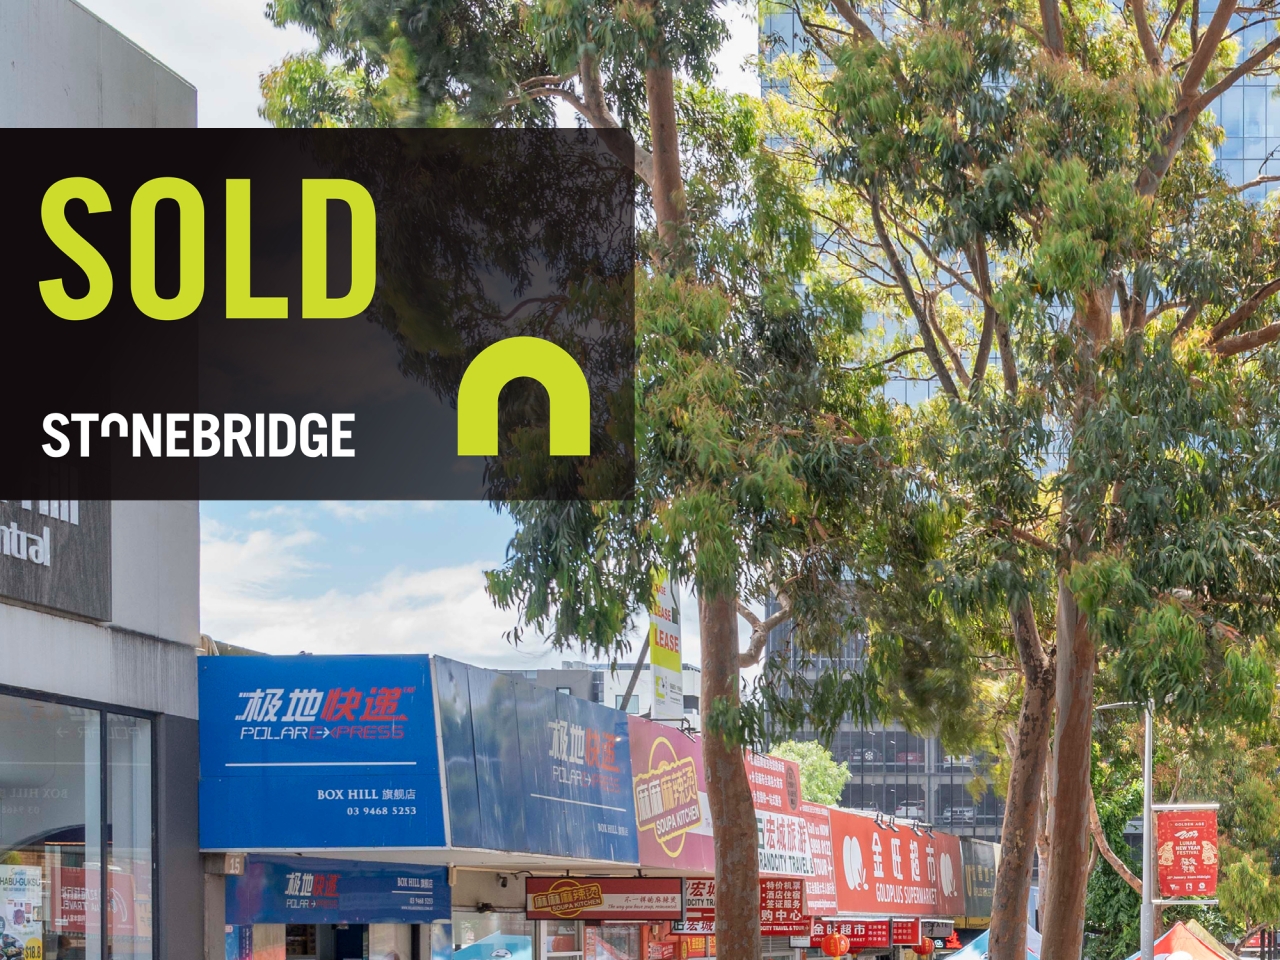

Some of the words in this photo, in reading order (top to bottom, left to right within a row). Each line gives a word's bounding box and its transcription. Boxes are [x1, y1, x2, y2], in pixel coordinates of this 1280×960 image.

[655, 628, 679, 653] LEASE
[235, 687, 408, 722] 极地快递
[317, 789, 344, 800] BOX
[348, 789, 379, 800] HILL
[382, 789, 416, 800] 旗舰店
[347, 807, 360, 815] 03
[363, 807, 388, 815] 9468
[392, 807, 417, 815] 5253
[656, 817, 677, 834] SOUPA
[677, 805, 699, 826] KITCHEN
[607, 824, 618, 834] HILL
[872, 832, 936, 883] 金旺超市
[229, 858, 240, 874] 15
[789, 855, 809, 874] TRAVEL
[814, 858, 828, 876] TOUR
[397, 877, 408, 887] BOX
[408, 878, 420, 887] HILL
[766, 881, 801, 890] 特价机票
[766, 890, 801, 899] 酒店住宿
[876, 883, 904, 903] GOLDPLUS
[904, 886, 937, 904] SUPERMARKET
[552, 904, 573, 912] SOUPA
[574, 899, 601, 910] KITCHEN
[766, 900, 801, 909] 签证服务
[761, 909, 802, 921] 购中心
[813, 924, 865, 936] 金旺超市
